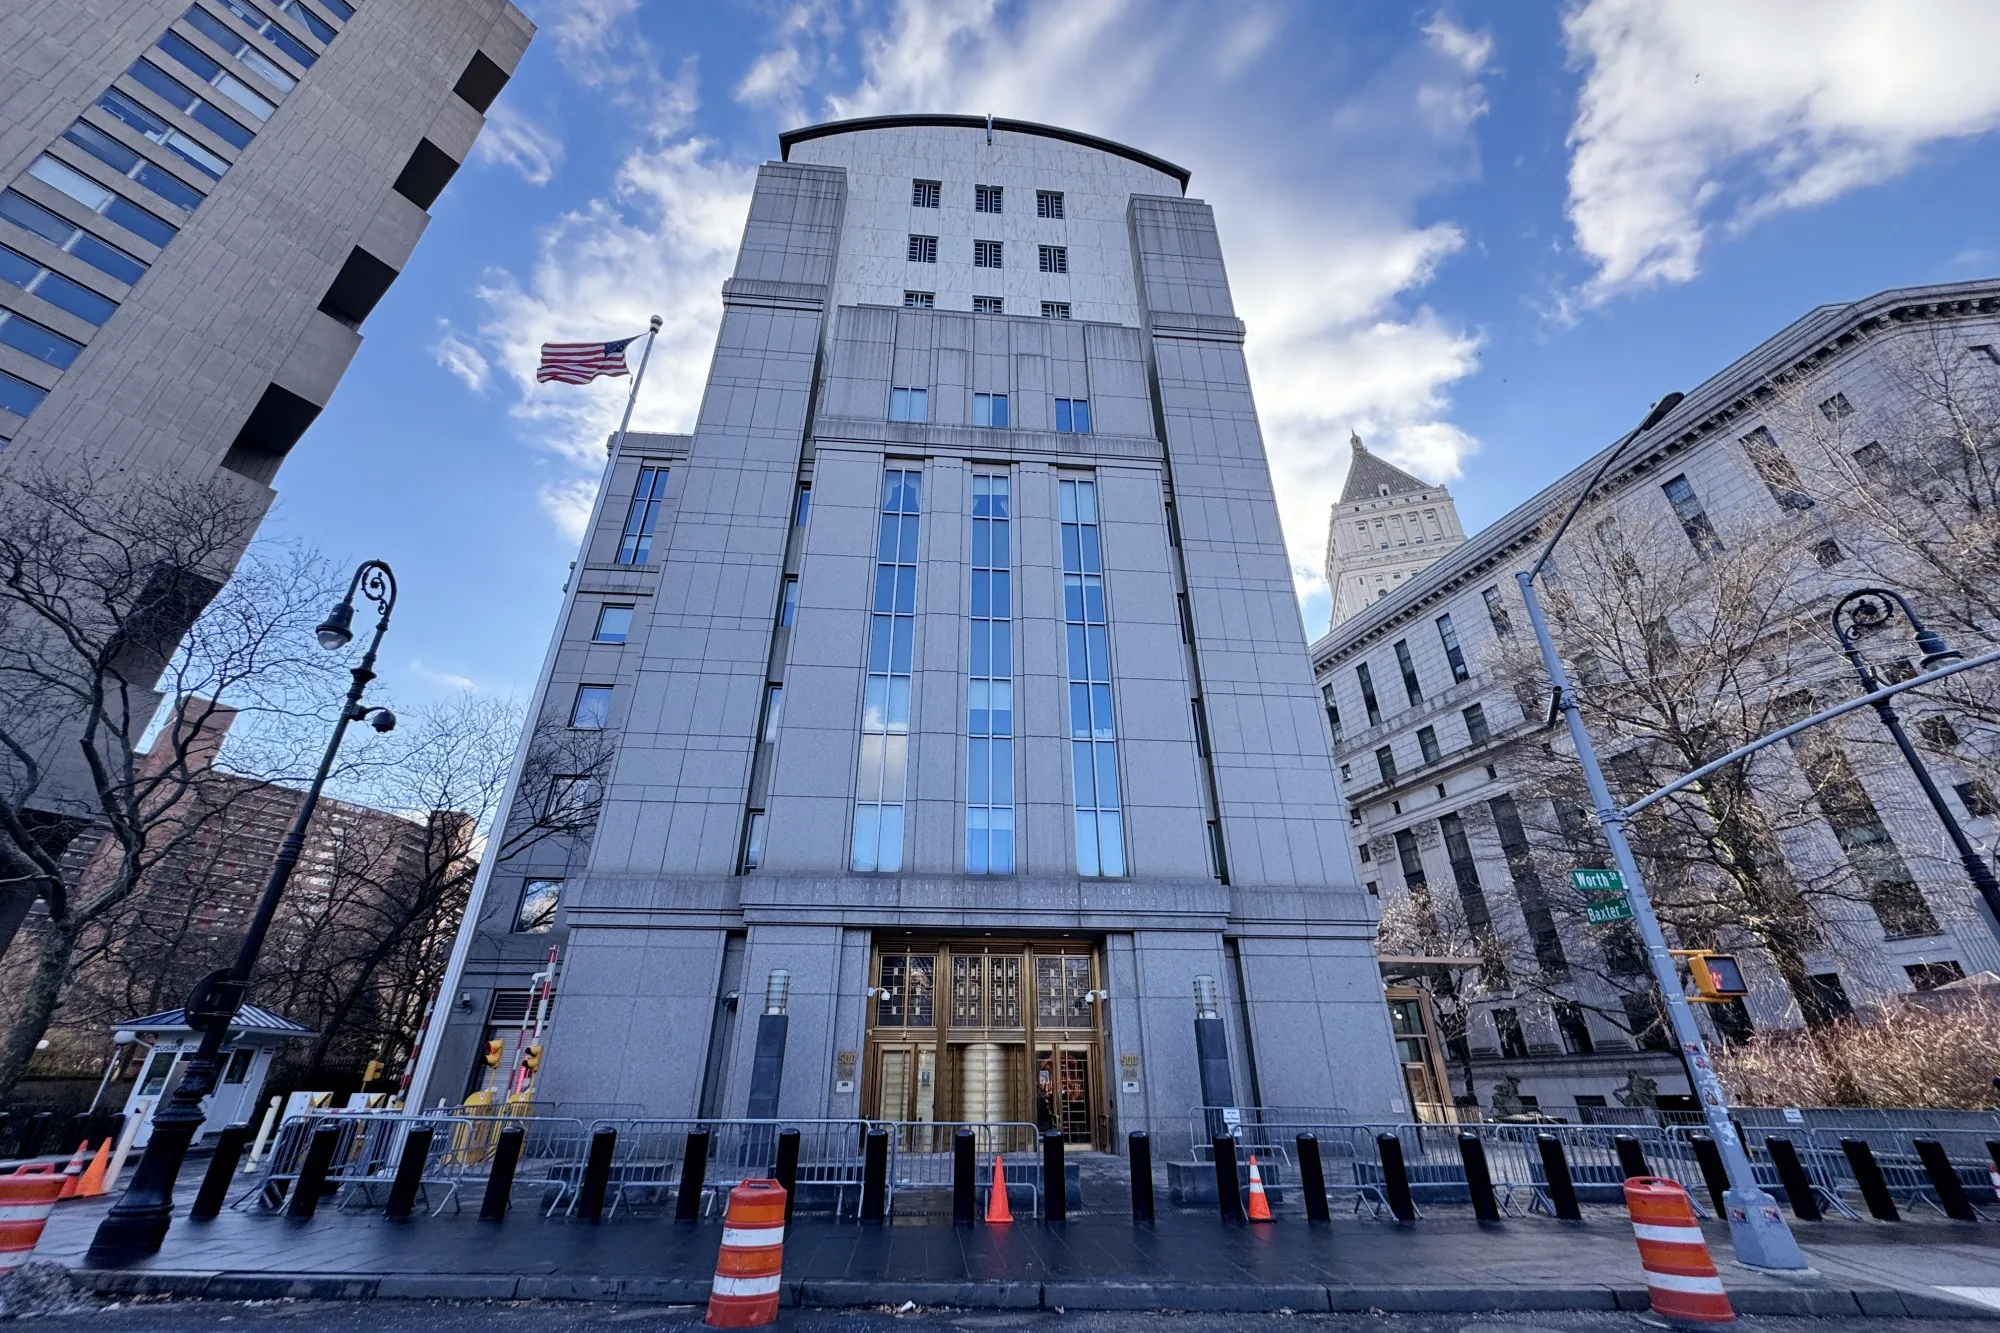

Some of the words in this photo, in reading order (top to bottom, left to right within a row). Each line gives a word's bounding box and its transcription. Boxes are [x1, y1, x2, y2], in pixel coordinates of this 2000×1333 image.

[1575, 872, 1610, 887] Worth
[1608, 871, 1618, 881] St
[1587, 905, 1620, 922] Baxter
[1620, 900, 1628, 909] St
[838, 1052, 857, 1064] 500
[1119, 1055, 1138, 1067] 500
